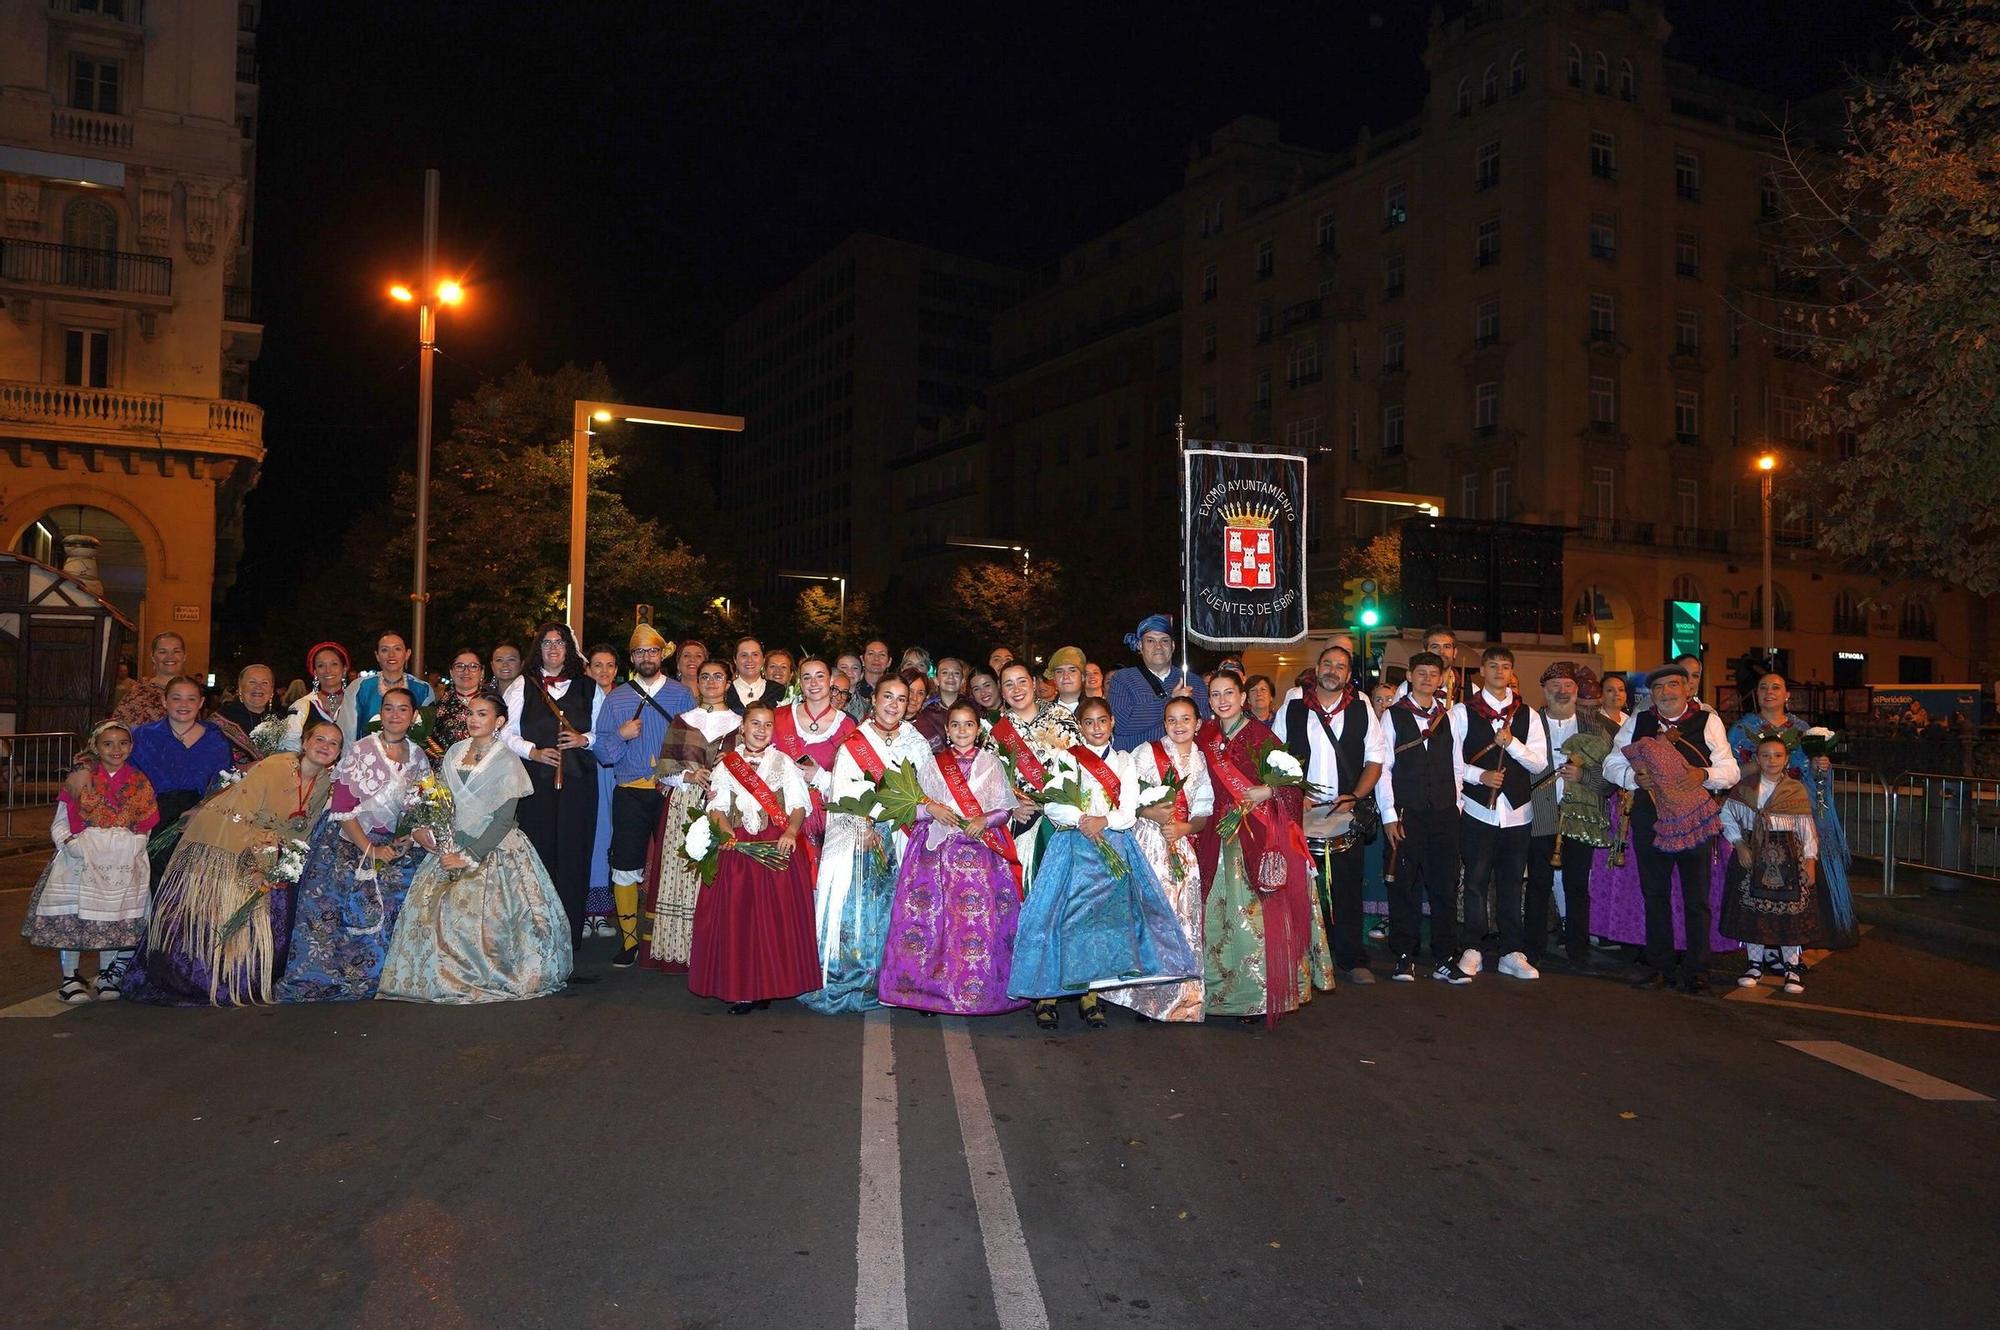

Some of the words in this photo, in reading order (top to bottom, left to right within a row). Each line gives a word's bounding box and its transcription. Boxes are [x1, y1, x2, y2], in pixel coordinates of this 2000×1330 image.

[1199, 483, 1227, 516] EXCMO
[1227, 479, 1295, 523] AYUNTAMIENTO
[1199, 587, 1254, 616] FUENTES
[1256, 602, 1272, 615] DE
[1273, 588, 1295, 612] EBRO
[1838, 651, 1865, 661] SEPHORA
[854, 743, 875, 768] Reina
[944, 763, 962, 784] Reina
